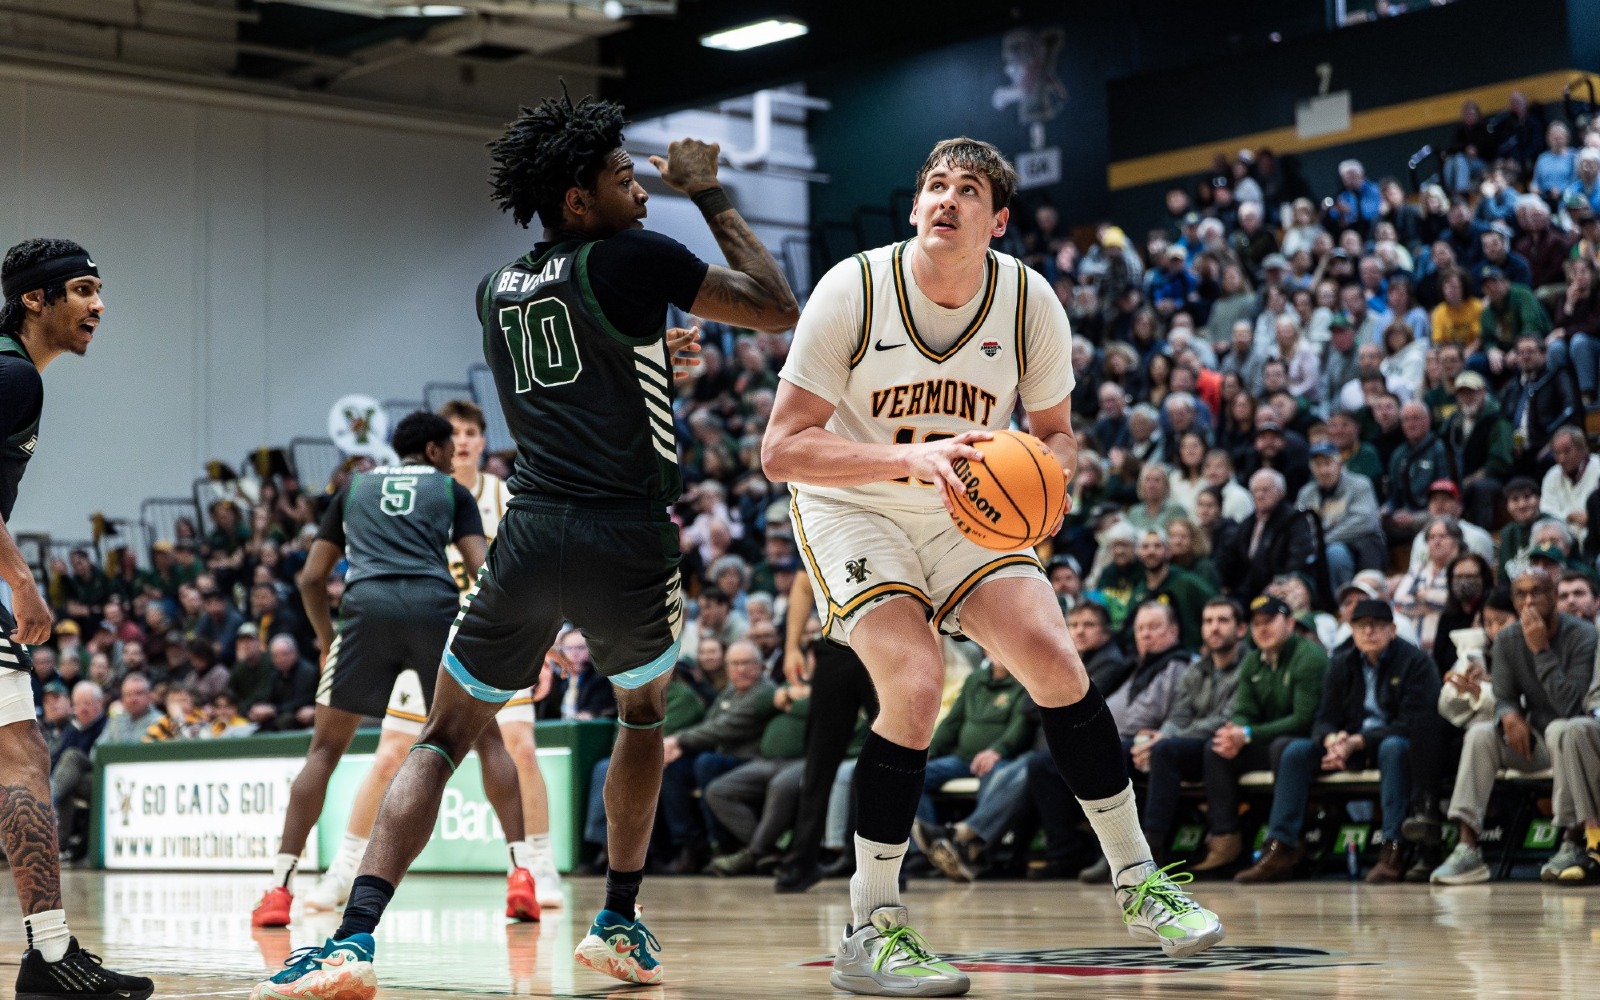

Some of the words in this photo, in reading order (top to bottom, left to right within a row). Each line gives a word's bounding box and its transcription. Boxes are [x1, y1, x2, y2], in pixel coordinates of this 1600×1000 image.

[499, 296, 583, 394] 10
[871, 378, 997, 427] VERMONT
[380, 476, 418, 516] 5
[952, 456, 1002, 525] Wilson
[142, 784, 166, 816] GO
[176, 783, 229, 815] CATS
[240, 781, 274, 814] GO!
[440, 786, 506, 842] Ban
